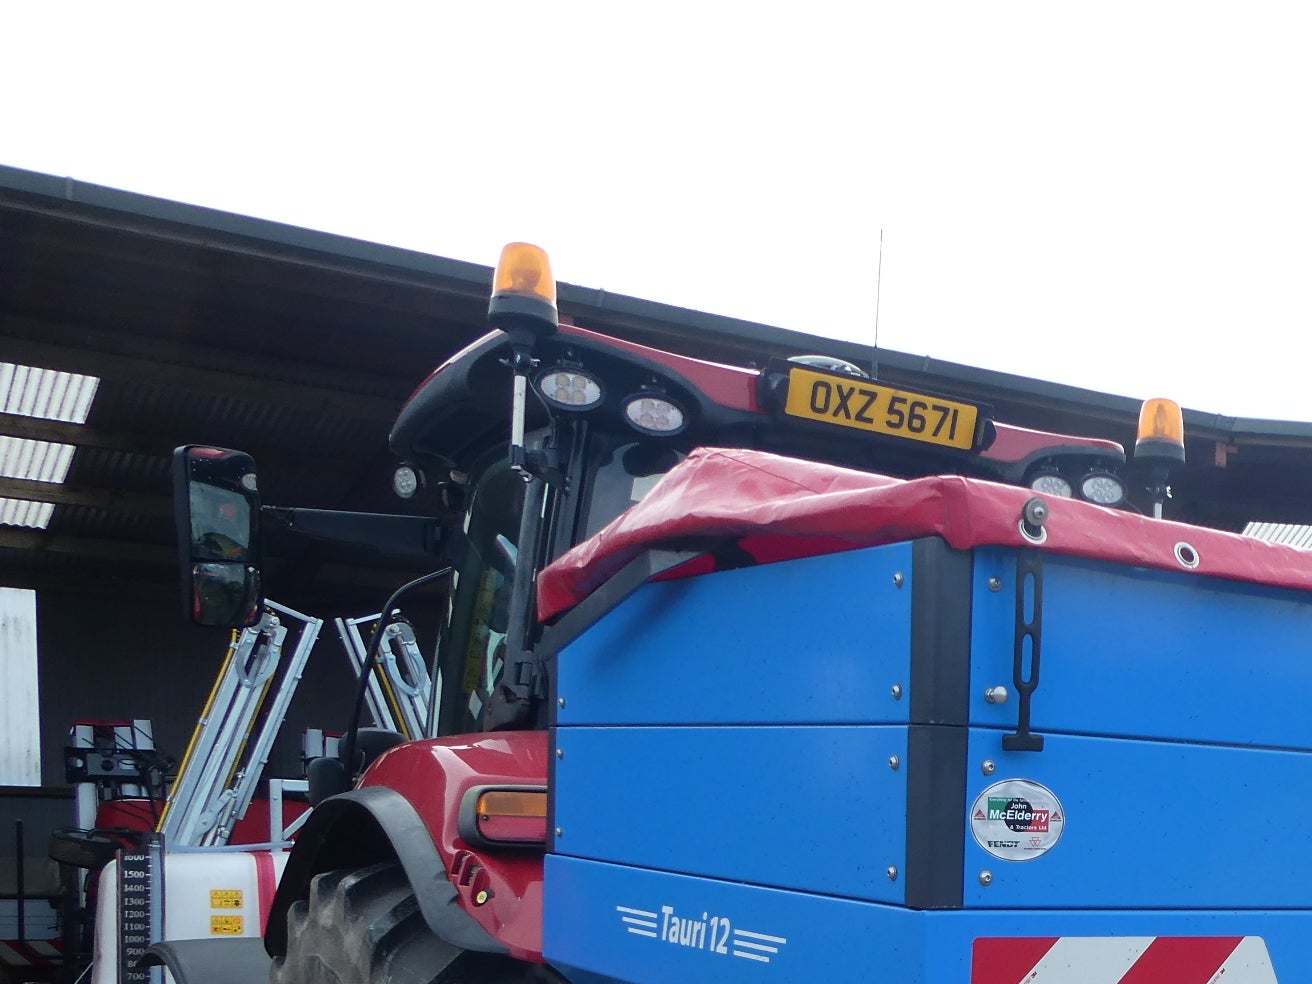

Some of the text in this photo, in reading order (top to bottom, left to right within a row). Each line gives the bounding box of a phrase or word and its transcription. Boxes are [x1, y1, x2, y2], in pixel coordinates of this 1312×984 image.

[810, 380, 959, 441] OXZ 5671
[989, 809, 1048, 822] McElderry
[987, 840, 1020, 848] FENDT
[124, 870, 145, 879] 1500
[124, 884, 145, 892] 1400
[124, 897, 145, 906] 1300
[124, 910, 145, 918] 1200
[124, 922, 145, 931] 1100
[661, 905, 731, 955] Tauri 12
[124, 935, 145, 943] 1000
[126, 947, 145, 956] 900
[127, 972, 145, 980] 700
